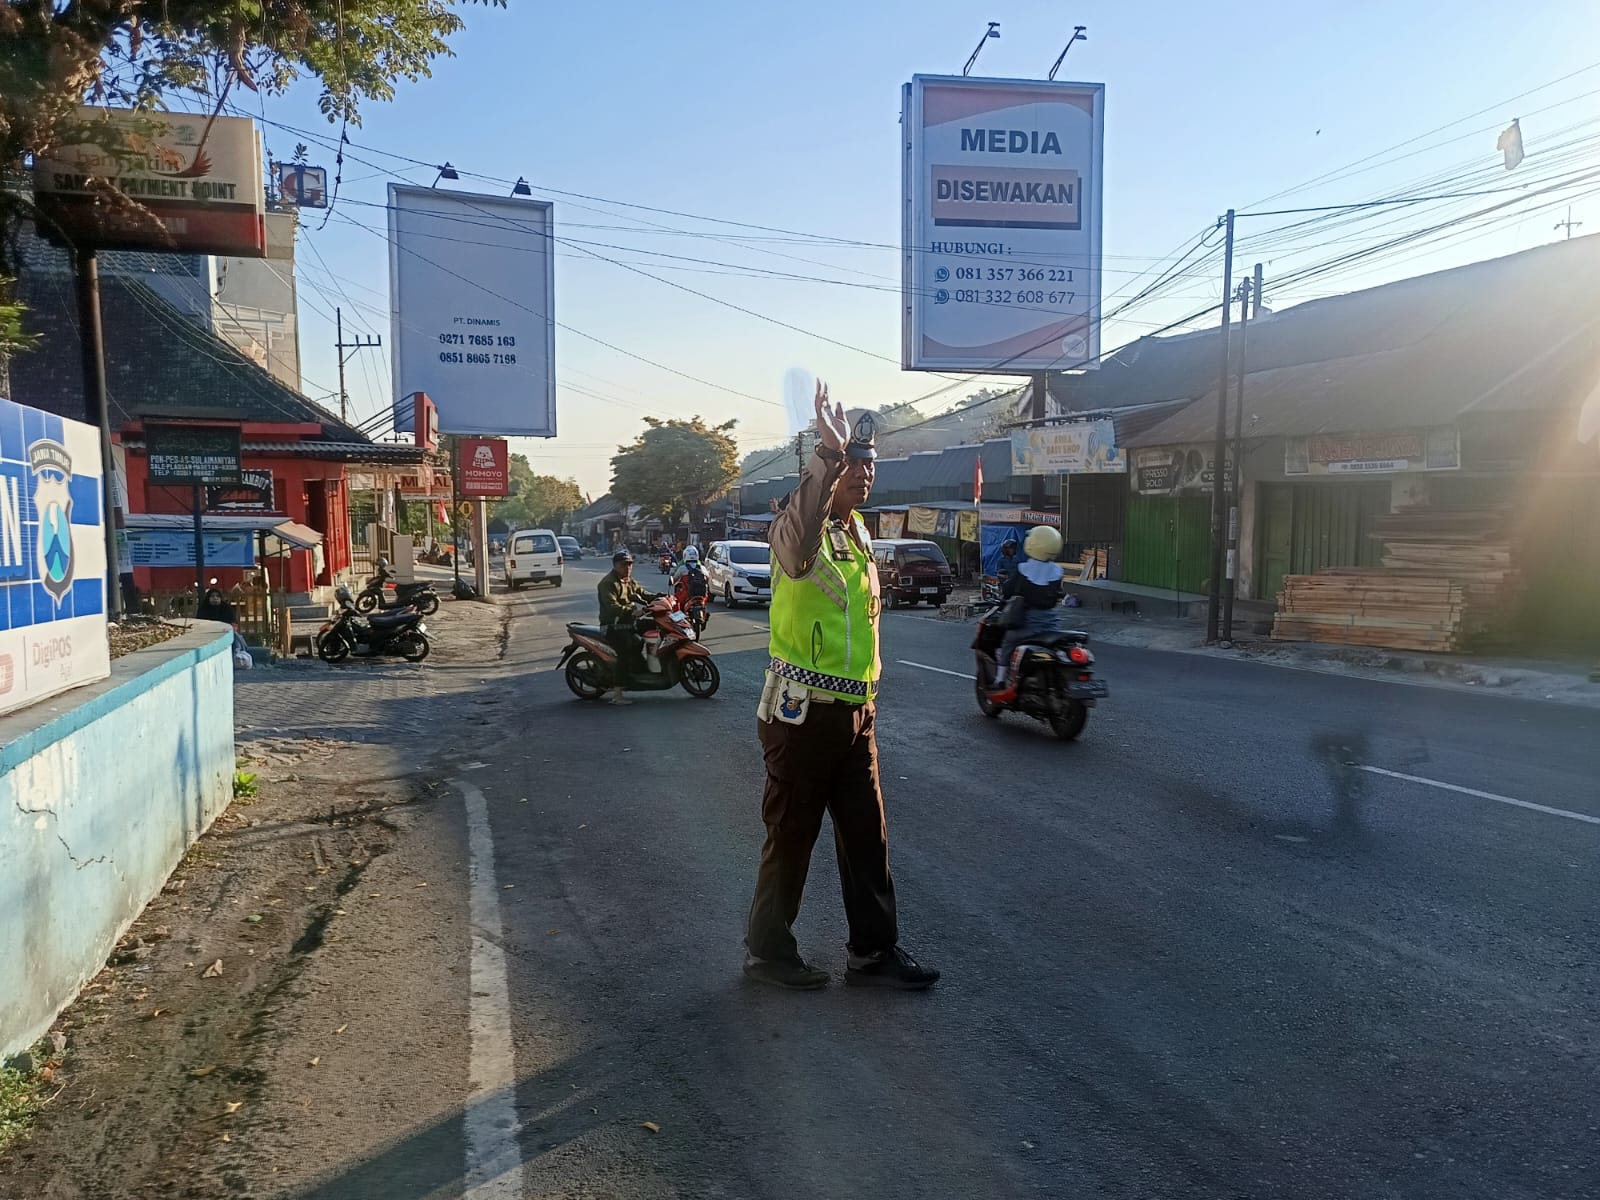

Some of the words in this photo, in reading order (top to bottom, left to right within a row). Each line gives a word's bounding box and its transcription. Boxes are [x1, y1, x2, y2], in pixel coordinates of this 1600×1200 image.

[961, 129, 1062, 155] MEDIA
[937, 178, 1074, 205] DISEWAKAN
[955, 267, 982, 281] 081
[987, 268, 1014, 282] 357
[1018, 268, 1045, 282] 366
[1048, 269, 1074, 282] 221
[955, 290, 980, 303] 081
[985, 290, 1011, 304] 332
[1017, 291, 1044, 304] 608
[1048, 291, 1075, 305] 677
[453, 317, 465, 325] PT.
[467, 318, 501, 326] DINAMIS
[468, 335, 494, 346] 7685
[439, 352, 463, 363] 0851
[32, 635, 72, 668] DigiPOS
